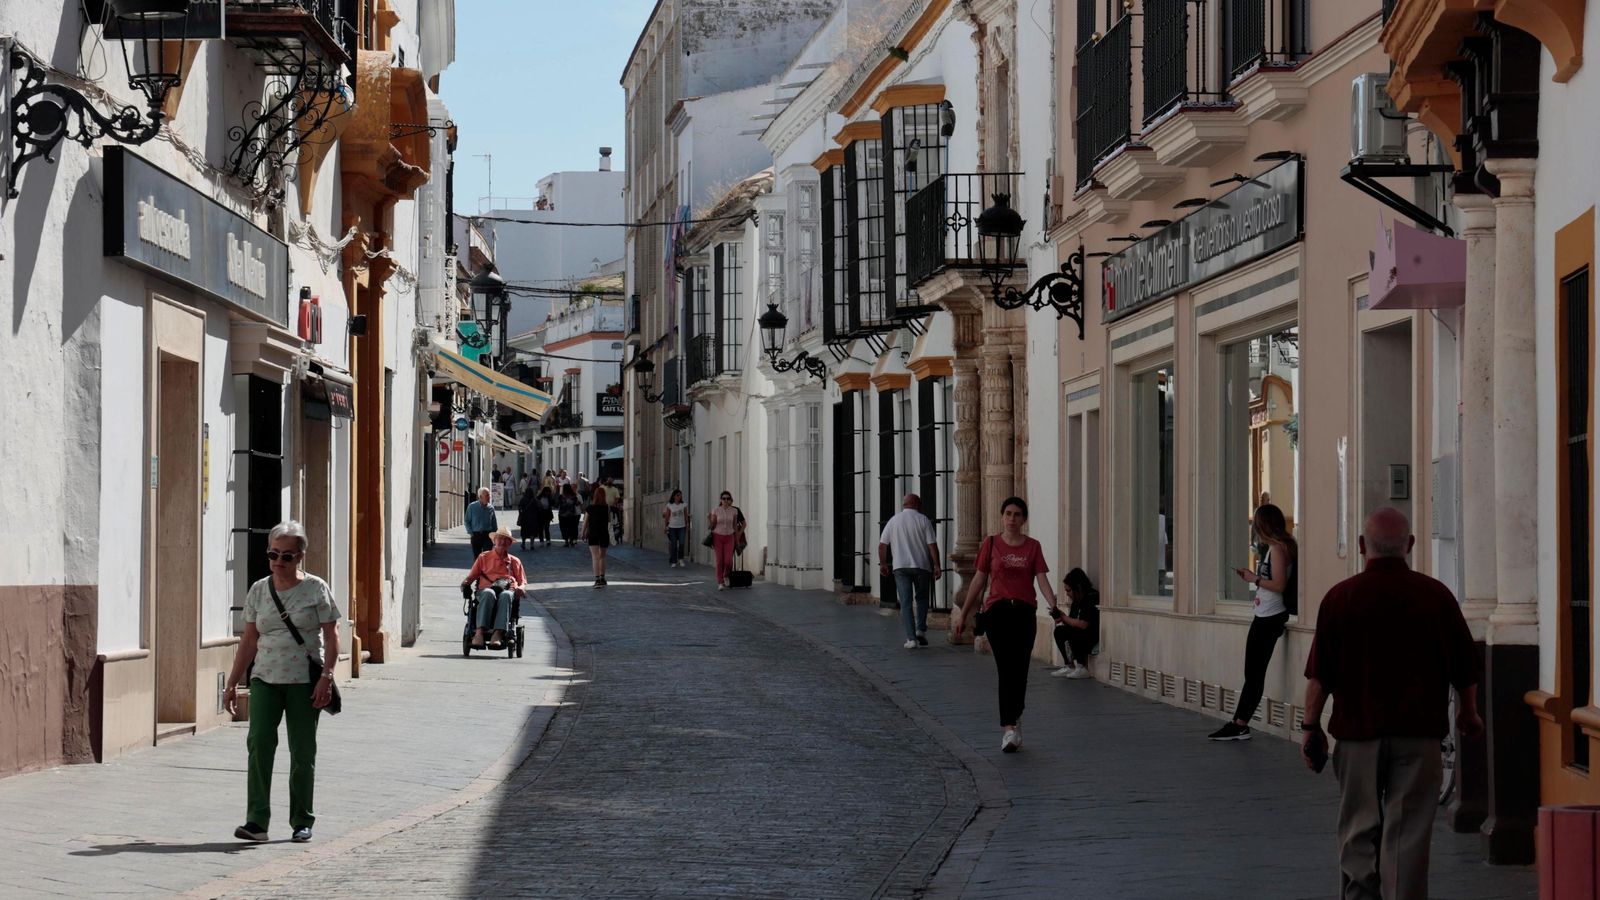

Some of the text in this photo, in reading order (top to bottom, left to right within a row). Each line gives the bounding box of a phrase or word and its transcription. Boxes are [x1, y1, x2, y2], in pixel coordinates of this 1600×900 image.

[1147, 221, 1184, 298] climent
[1193, 217, 1230, 262] bienvenidos
[1236, 202, 1261, 240] vuestra
[1263, 194, 1281, 230] casa
